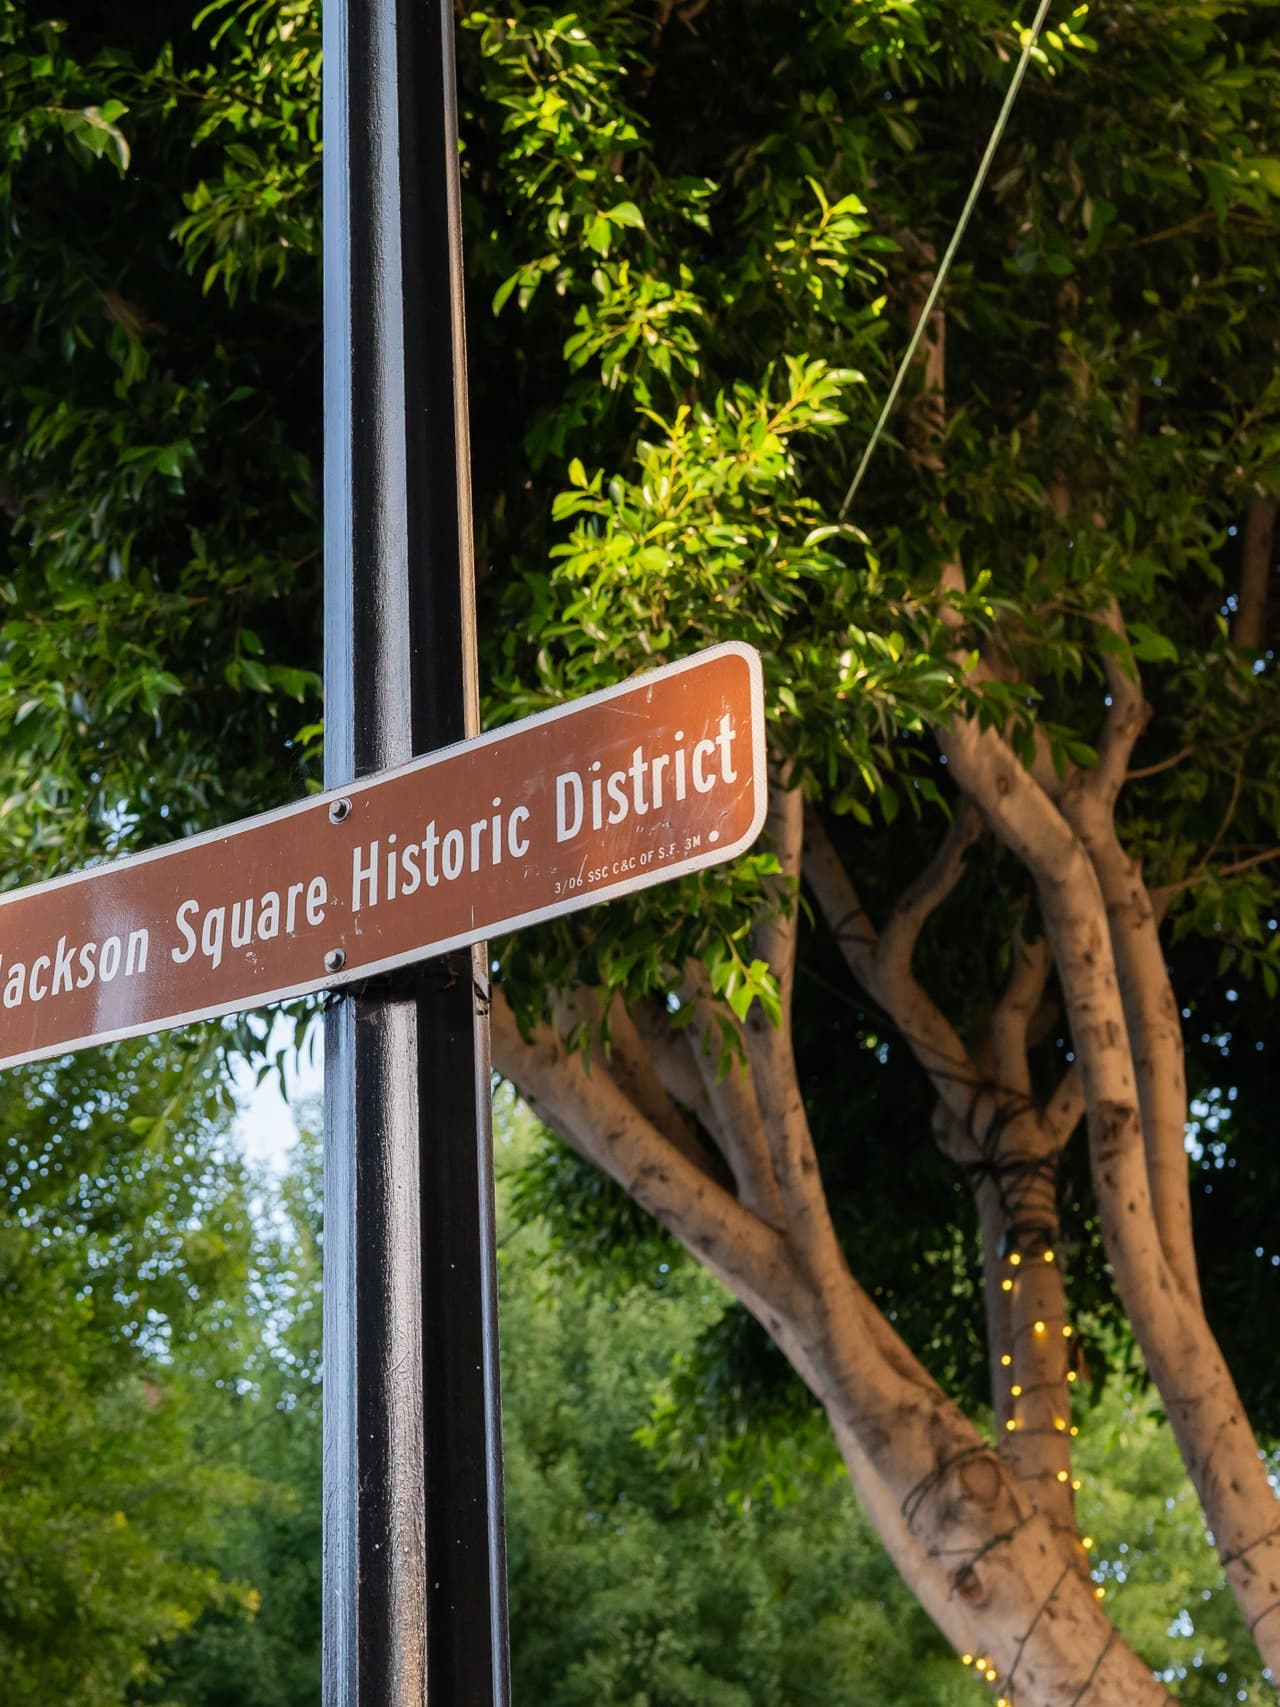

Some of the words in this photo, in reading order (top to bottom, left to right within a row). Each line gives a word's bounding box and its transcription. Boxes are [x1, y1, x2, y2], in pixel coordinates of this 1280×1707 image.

[171, 876, 328, 970] Square
[352, 797, 530, 912] Historic
[556, 714, 737, 843] District
[554, 875, 584, 895] 3/06
[588, 866, 609, 883] SSC
[612, 857, 636, 875] C&C
[640, 850, 655, 865] OF
[658, 843, 680, 859] S.F.
[685, 834, 701, 850] 3M
